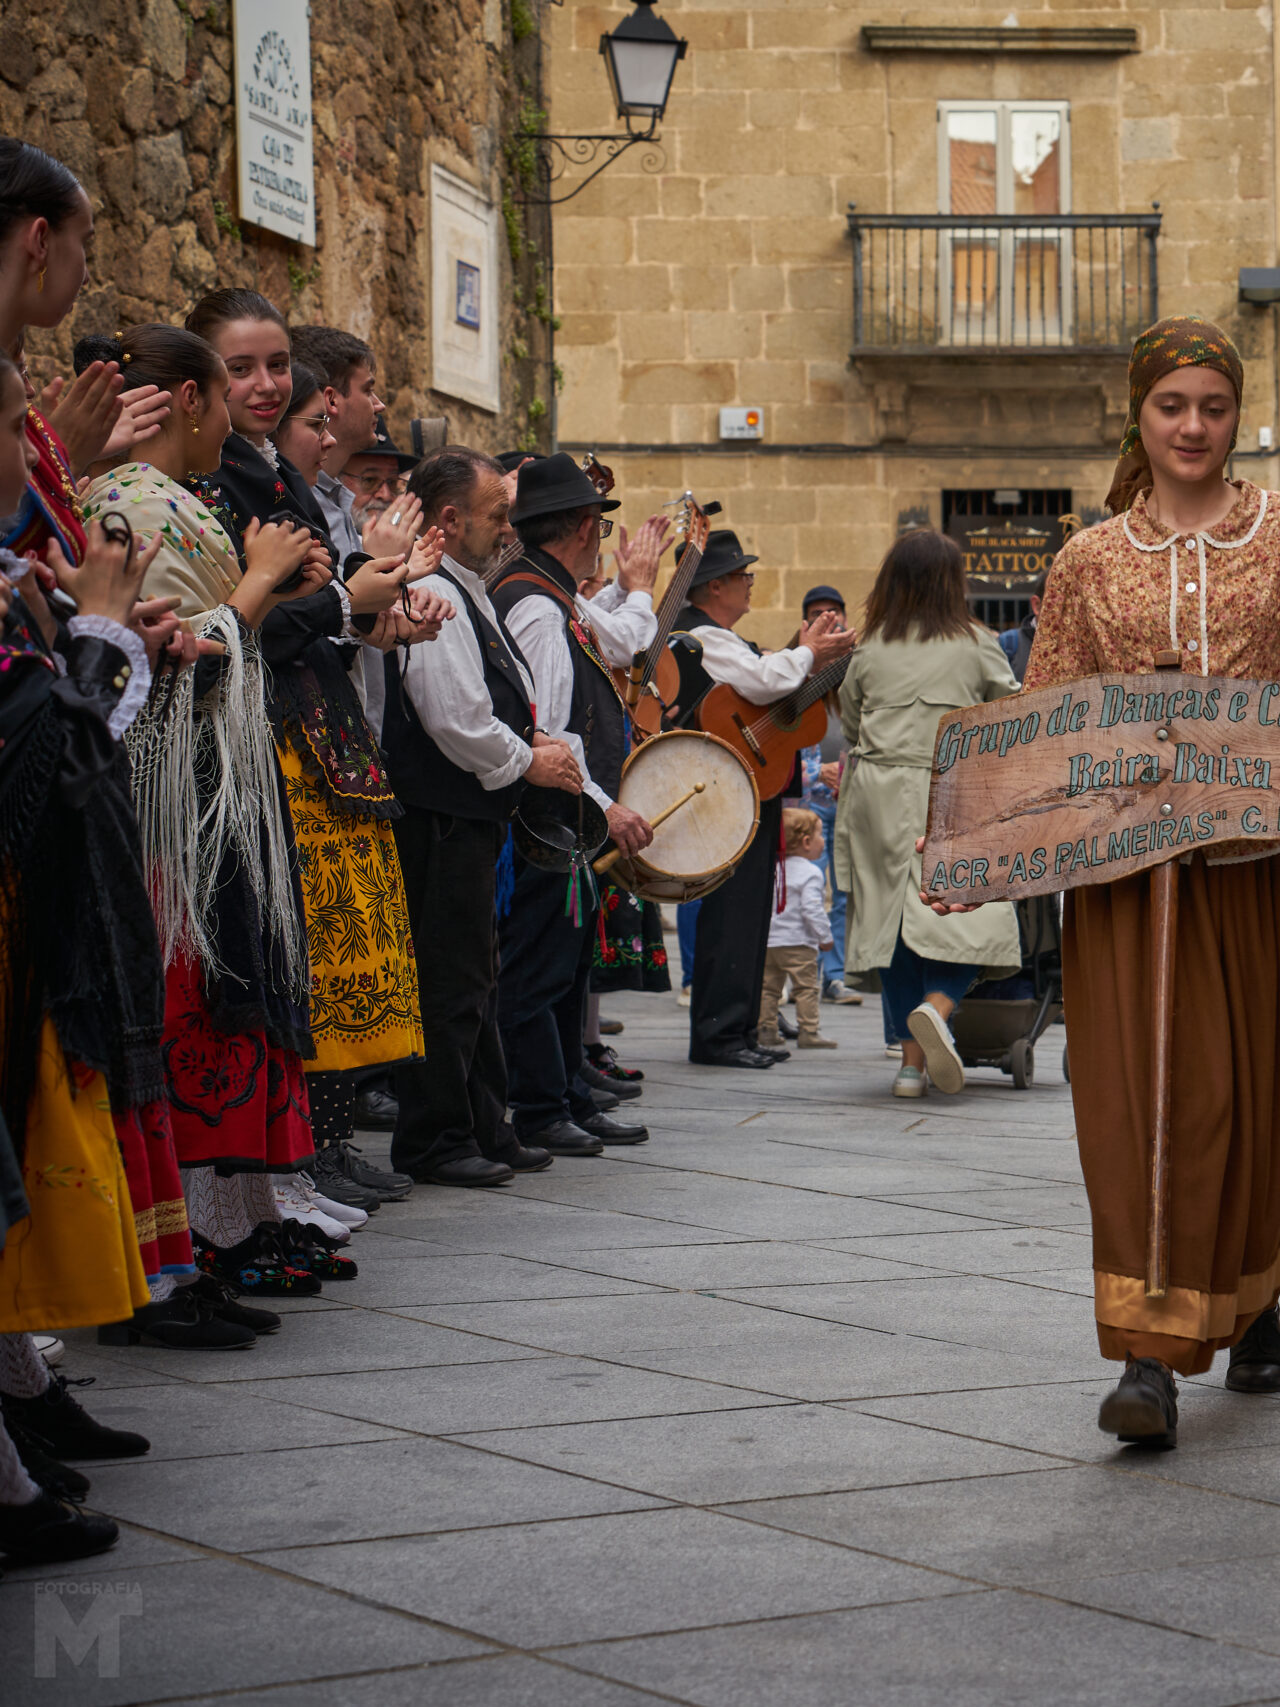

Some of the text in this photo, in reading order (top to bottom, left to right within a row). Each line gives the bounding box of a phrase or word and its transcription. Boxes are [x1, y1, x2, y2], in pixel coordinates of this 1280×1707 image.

[970, 537, 1046, 547] THE BLACK SHEEP
[936, 711, 1041, 774] Grupo
[1047, 693, 1090, 737] de
[1096, 684, 1221, 729] Danças
[1228, 691, 1249, 722] e
[1066, 742, 1273, 798] Beira Baixa
[929, 857, 990, 891] ACR
[998, 848, 1047, 883] "AS
[1055, 810, 1227, 875] PALMEIRAS"
[1241, 805, 1268, 833] C.
